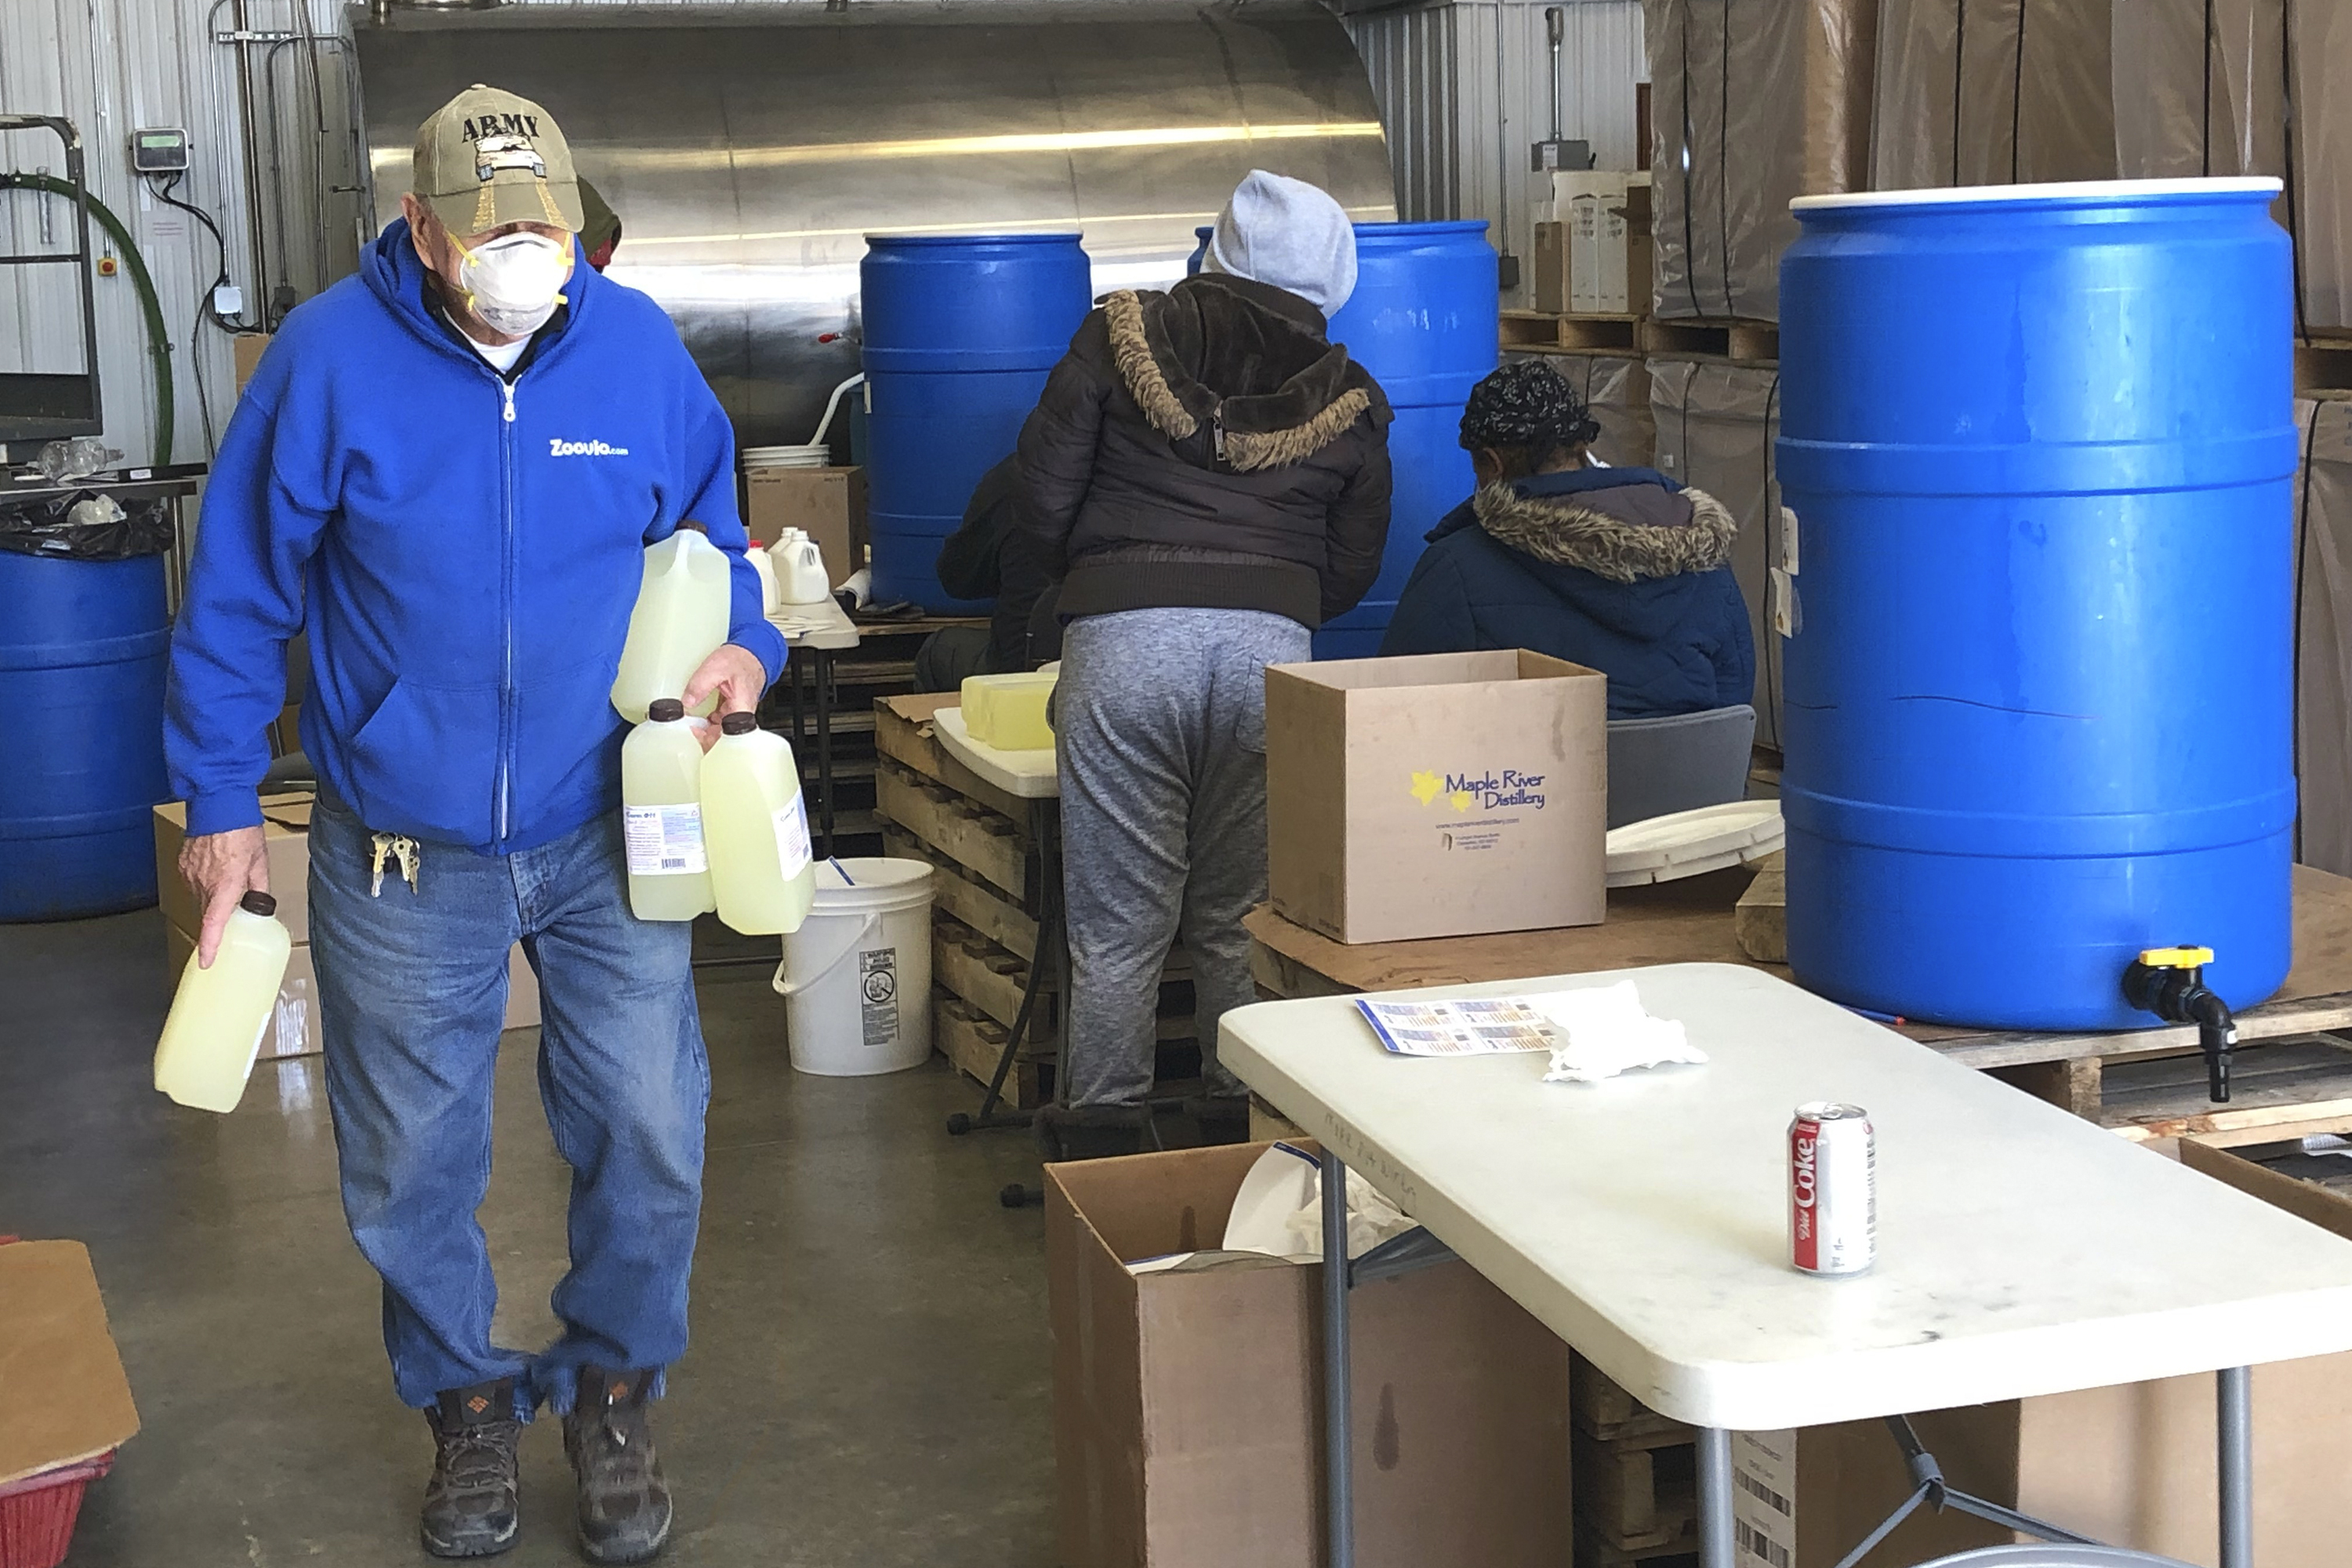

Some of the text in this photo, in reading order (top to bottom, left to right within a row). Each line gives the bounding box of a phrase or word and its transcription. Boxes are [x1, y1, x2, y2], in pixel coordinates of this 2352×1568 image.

[462, 113, 540, 143] ARMY
[1446, 770, 1545, 800] Maple River
[1484, 789, 1545, 809] Distillery
[1793, 1138, 1815, 1208] Coke
